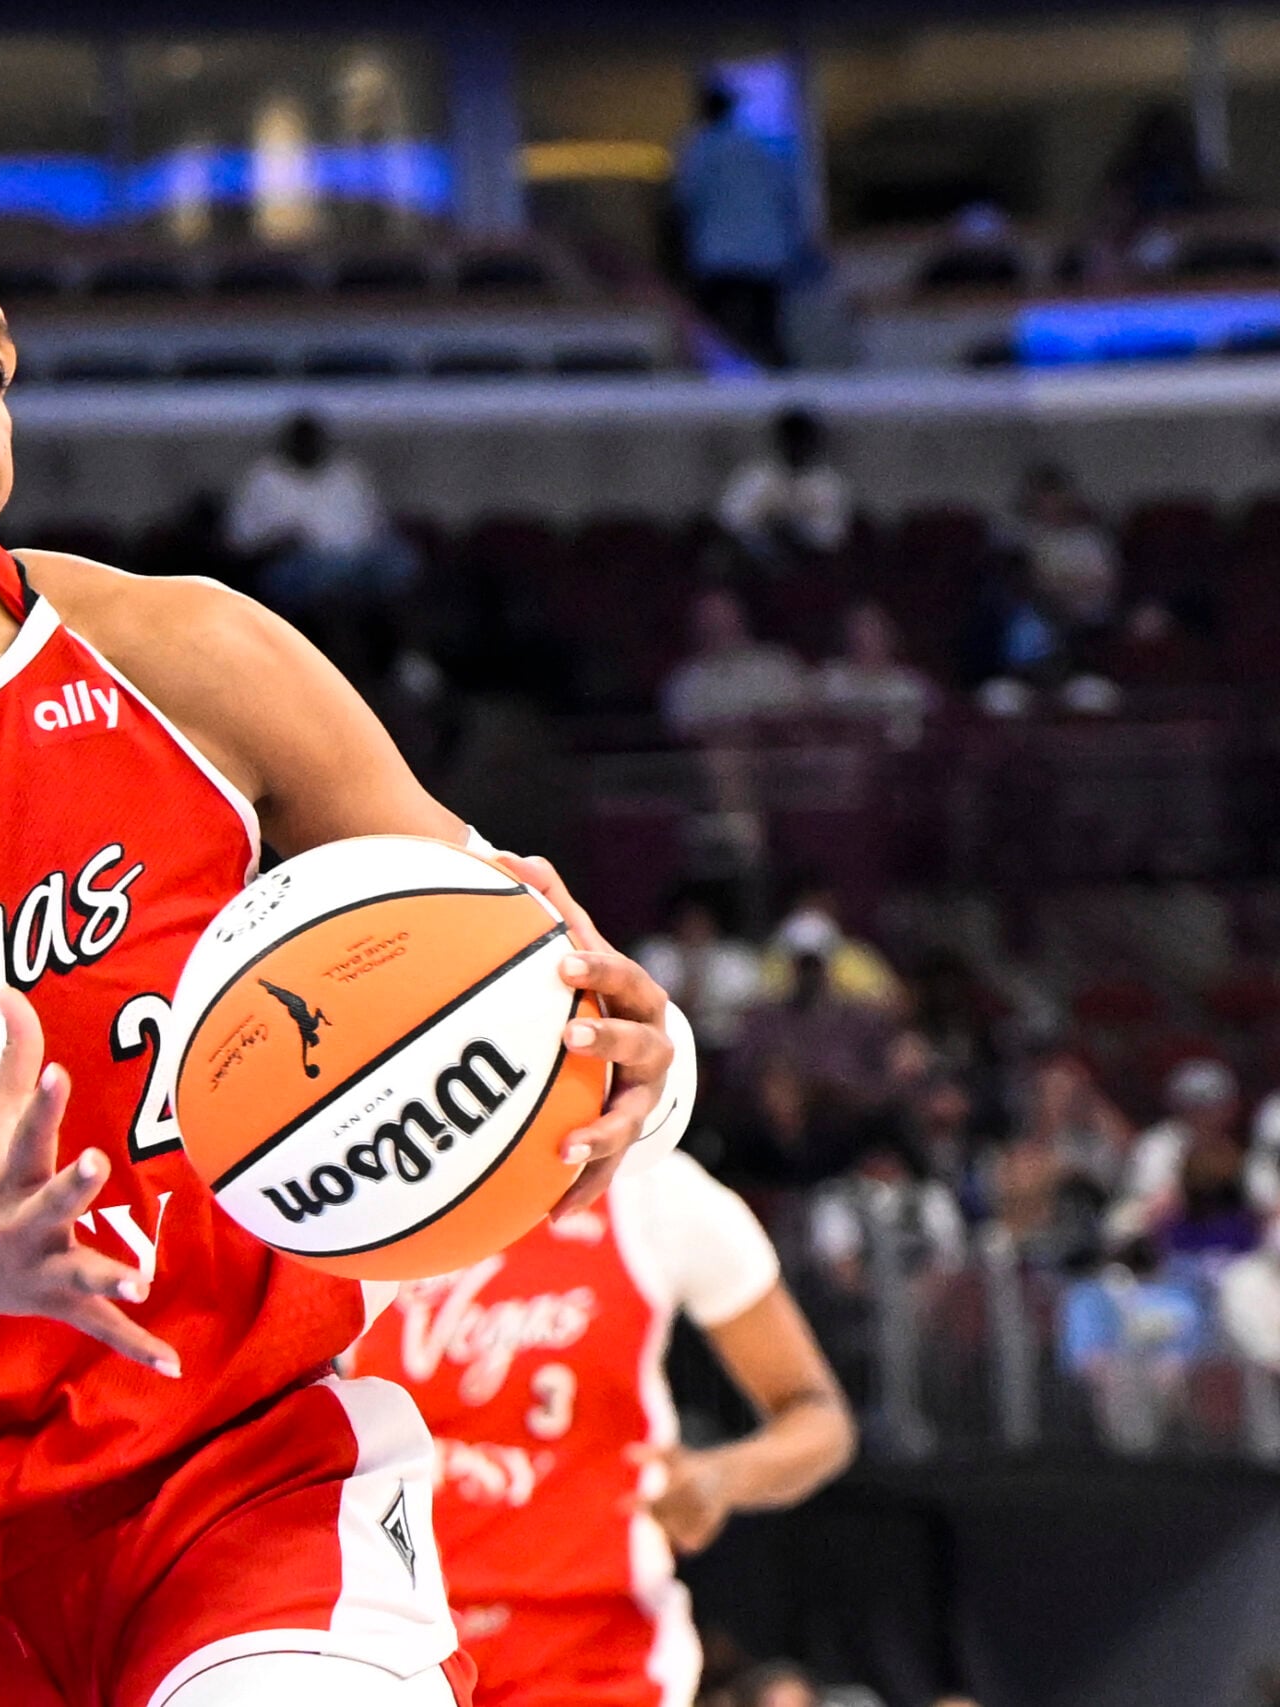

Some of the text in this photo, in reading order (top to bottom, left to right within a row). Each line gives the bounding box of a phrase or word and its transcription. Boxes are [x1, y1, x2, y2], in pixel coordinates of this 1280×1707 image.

[34, 680, 119, 731] ally
[259, 1037, 529, 1224] Wilson
[331, 1087, 395, 1139] EVO NXT
[396, 1252, 599, 1407] Vegas
[525, 1362, 578, 1441] 3
